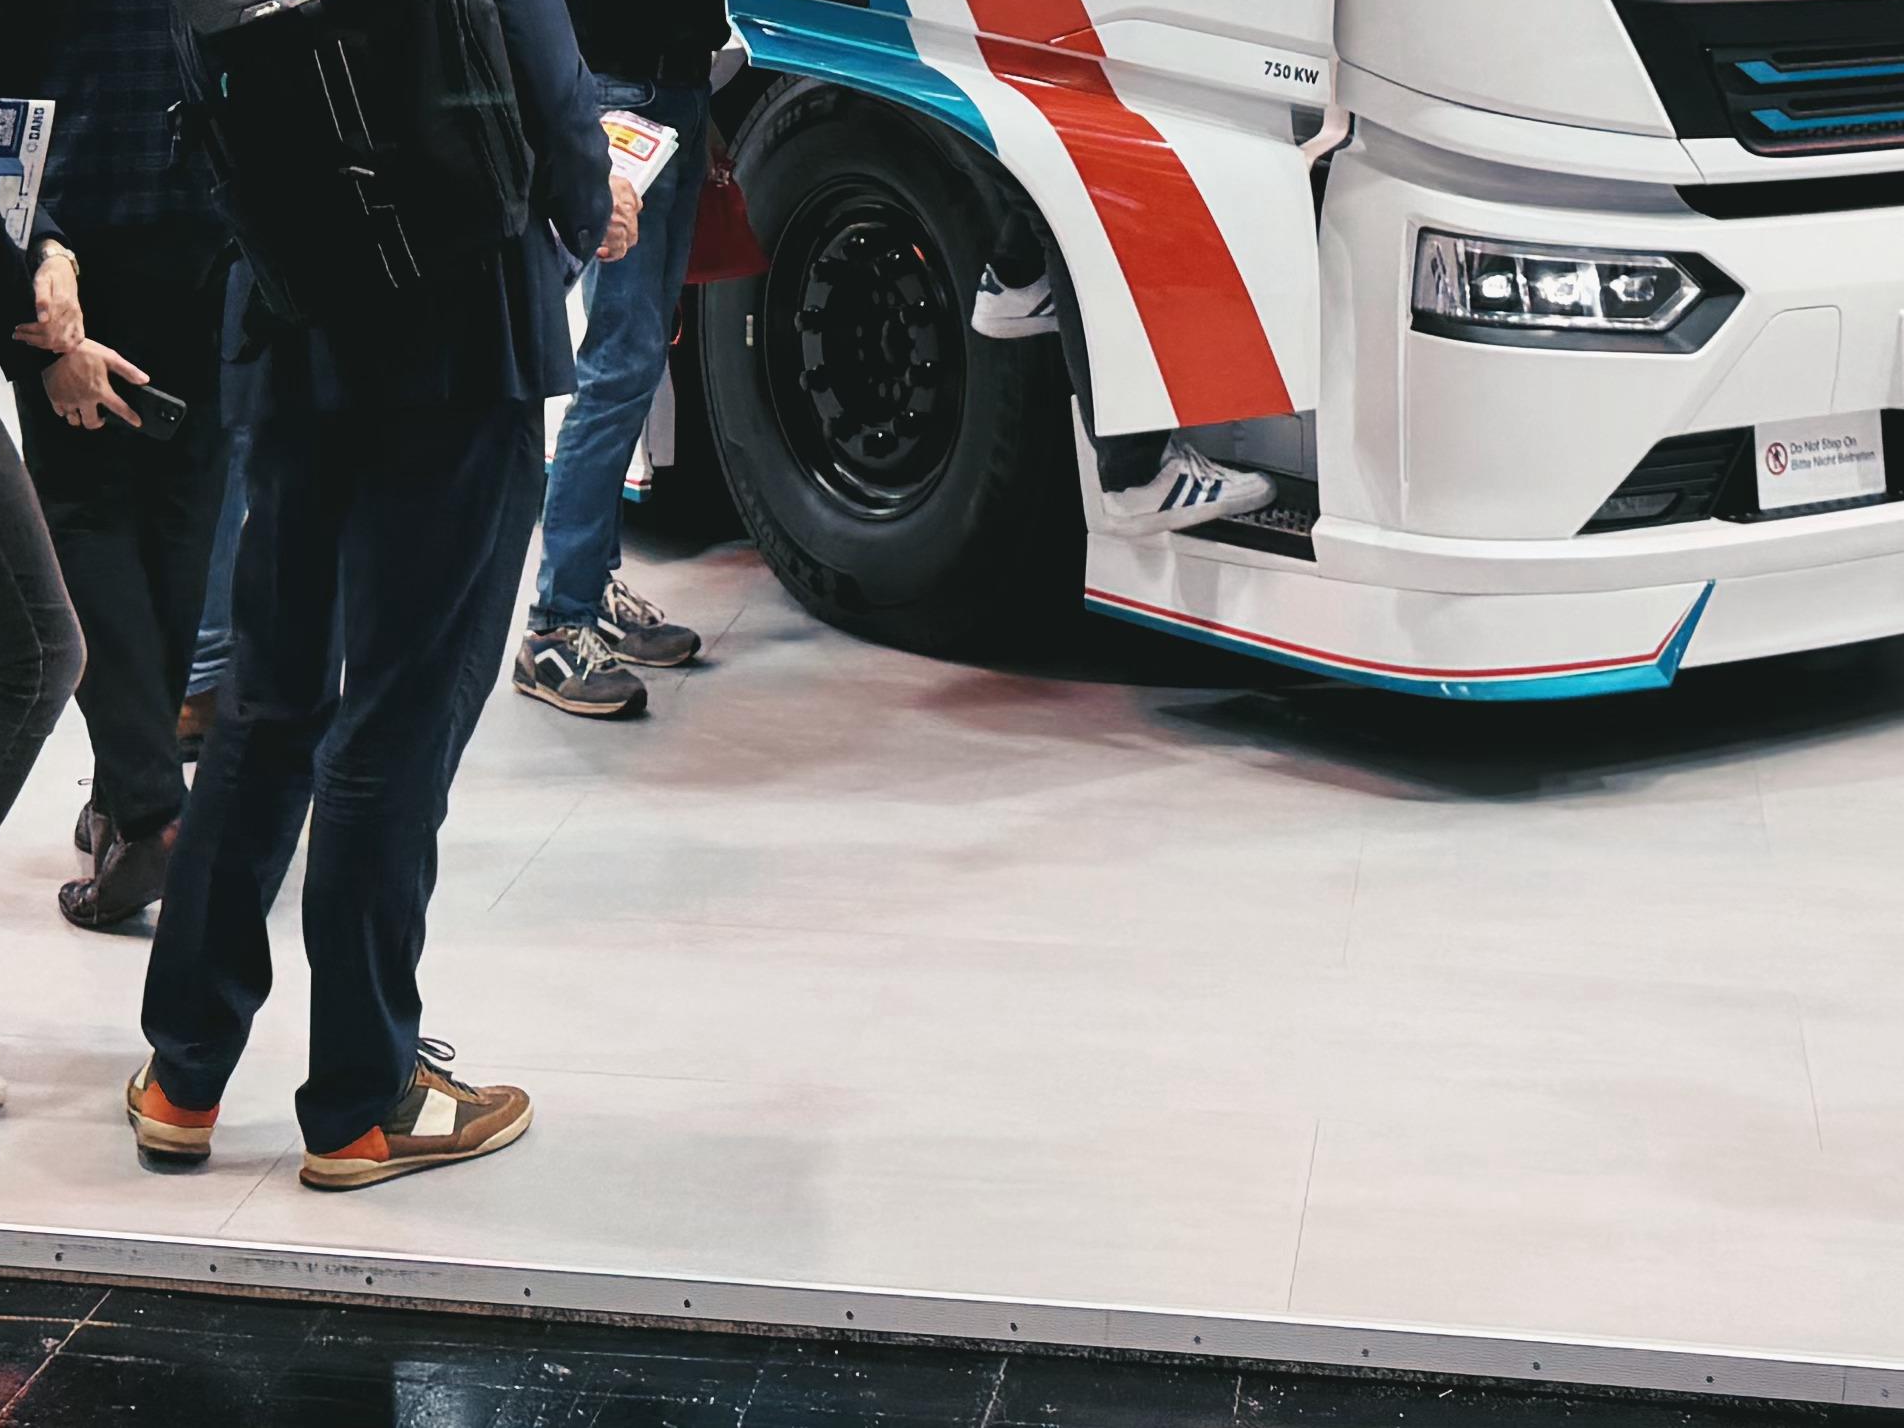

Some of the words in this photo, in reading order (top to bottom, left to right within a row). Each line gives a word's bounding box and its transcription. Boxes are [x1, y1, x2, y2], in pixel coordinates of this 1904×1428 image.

[1264, 60, 1291, 79] 750
[1294, 66, 1319, 85] KW
[1790, 442, 1803, 455] Do
[1804, 438, 1821, 452] Not
[1822, 437, 1842, 451] Step
[1843, 435, 1857, 447] On
[1813, 454, 1836, 467] Nicht
